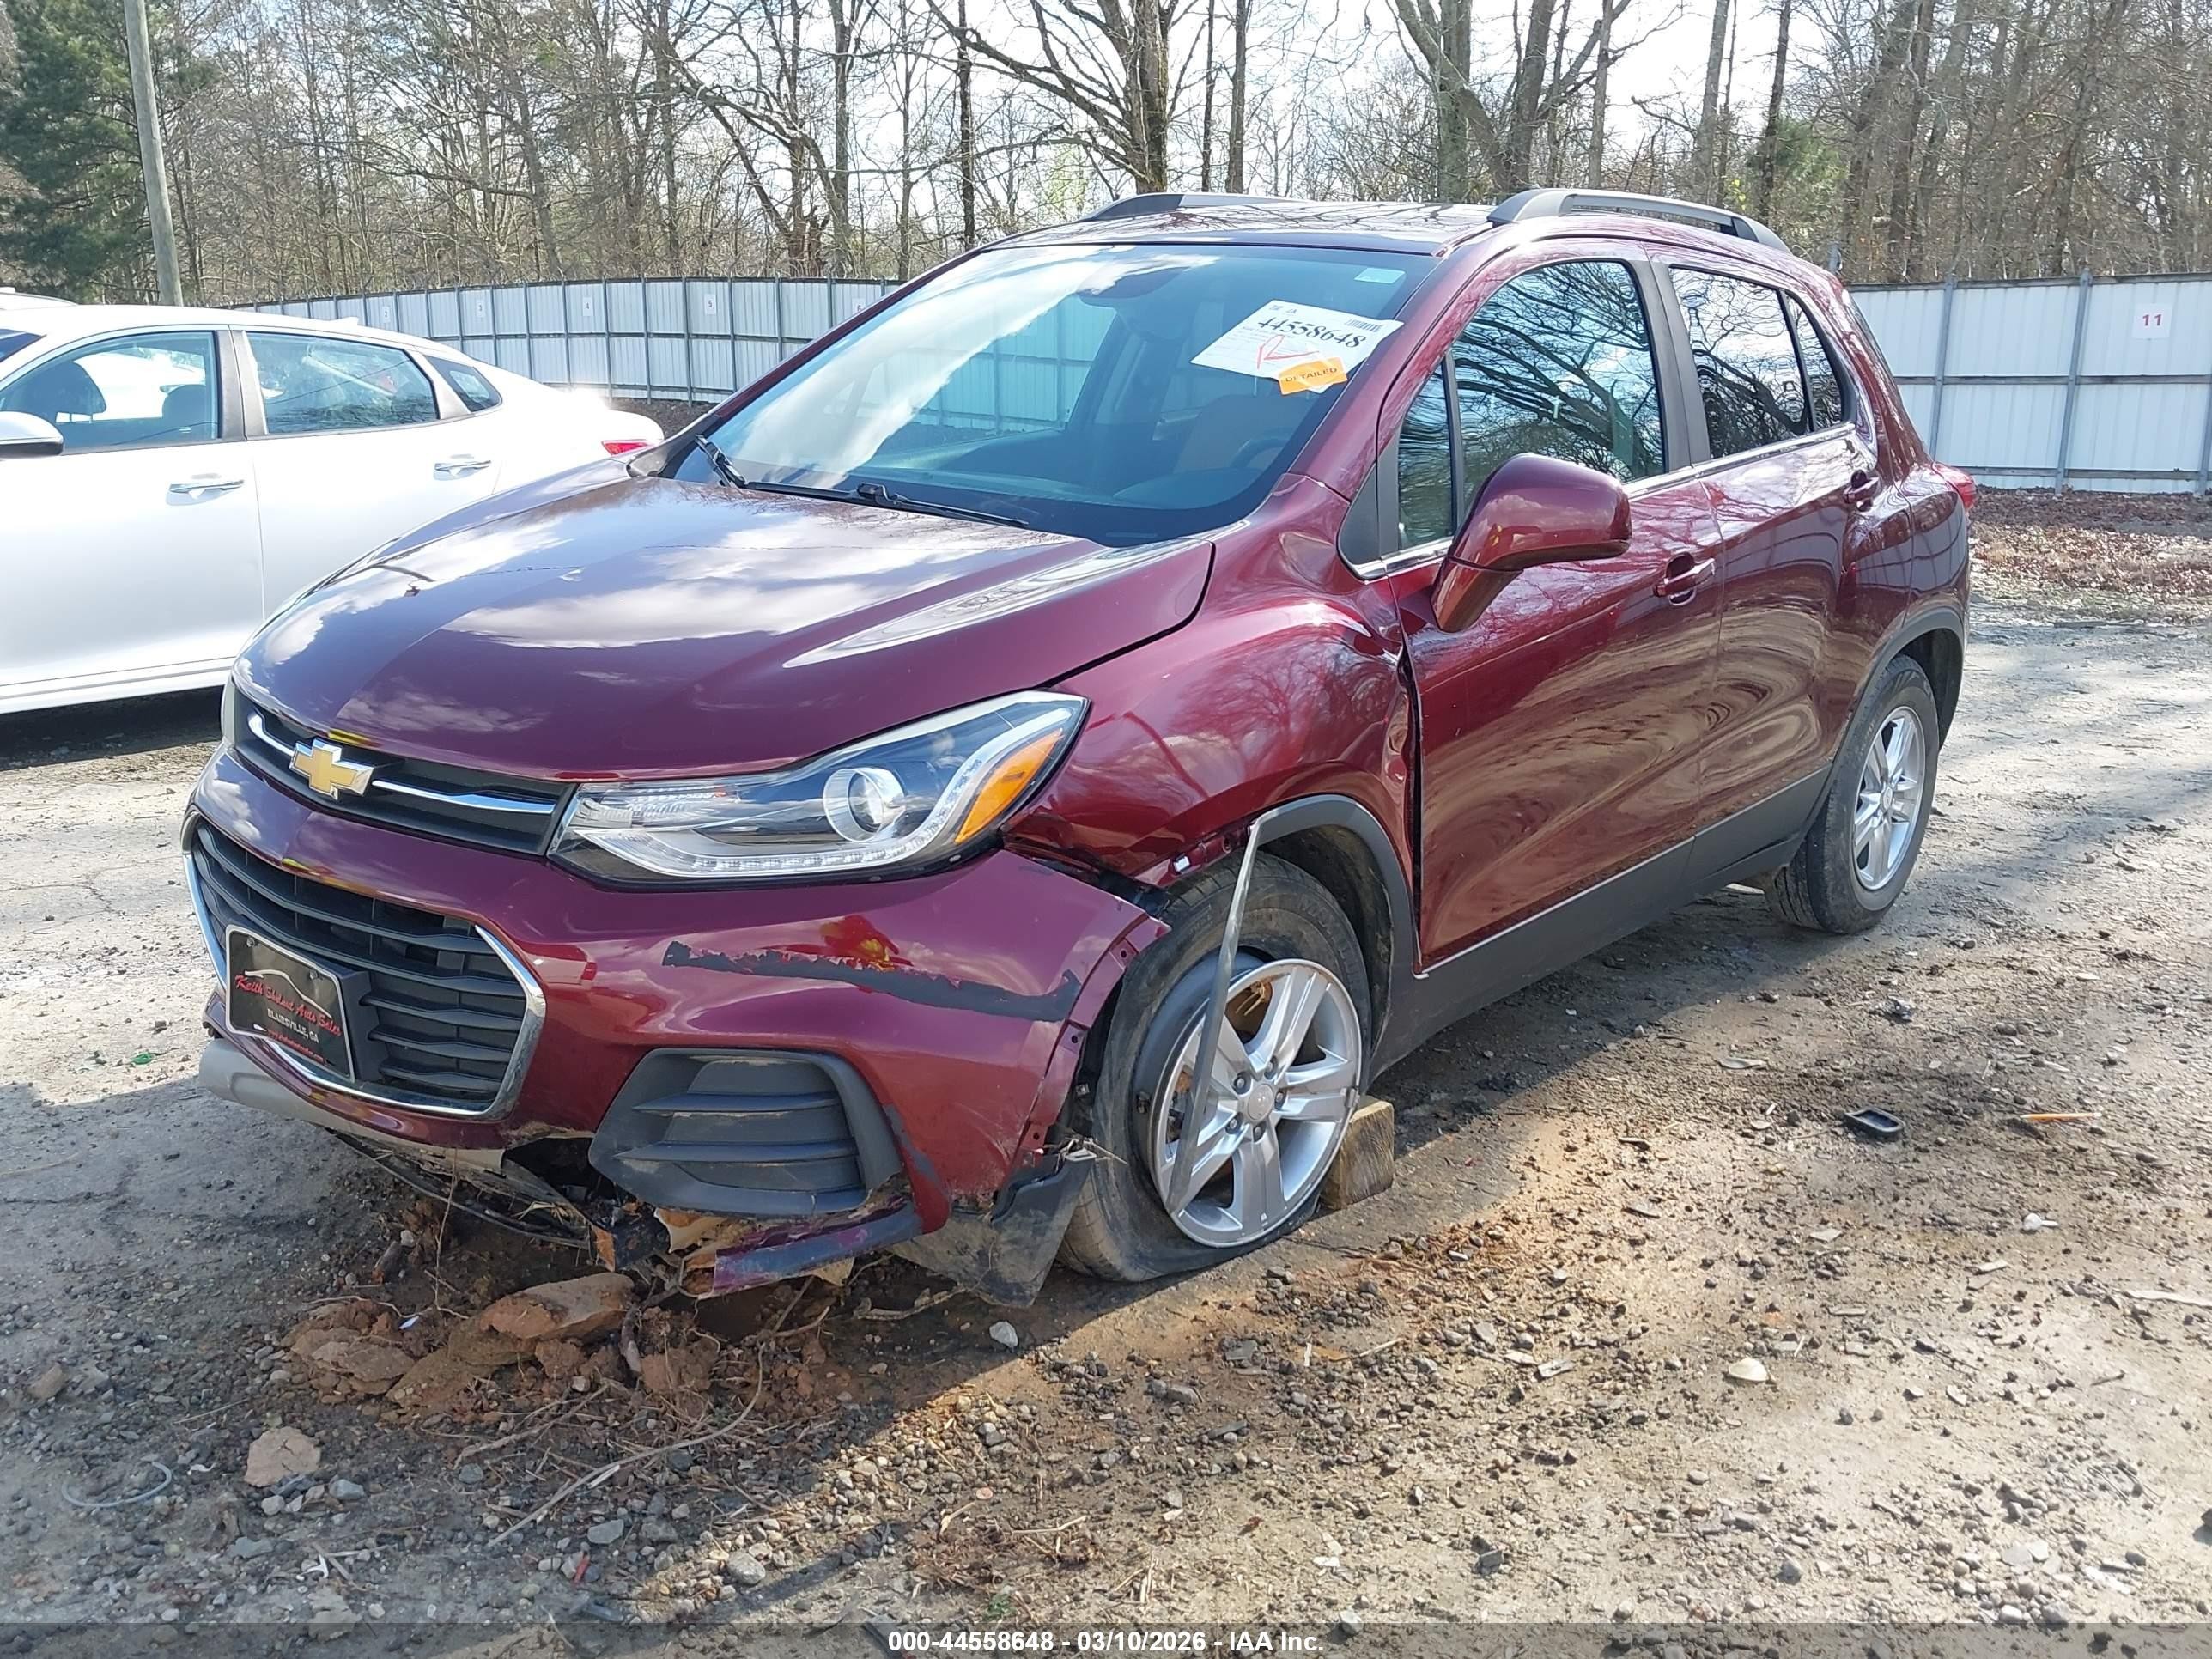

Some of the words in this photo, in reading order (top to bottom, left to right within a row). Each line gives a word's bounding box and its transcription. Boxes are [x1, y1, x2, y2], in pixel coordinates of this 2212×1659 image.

[2142, 313, 2162, 326] 11
[1258, 317, 1366, 348] 44558648
[234, 975, 263, 995] Keith
[296, 1004, 317, 1023] Auto
[319, 1013, 342, 1036] Sales
[309, 1030, 319, 1043] GA
